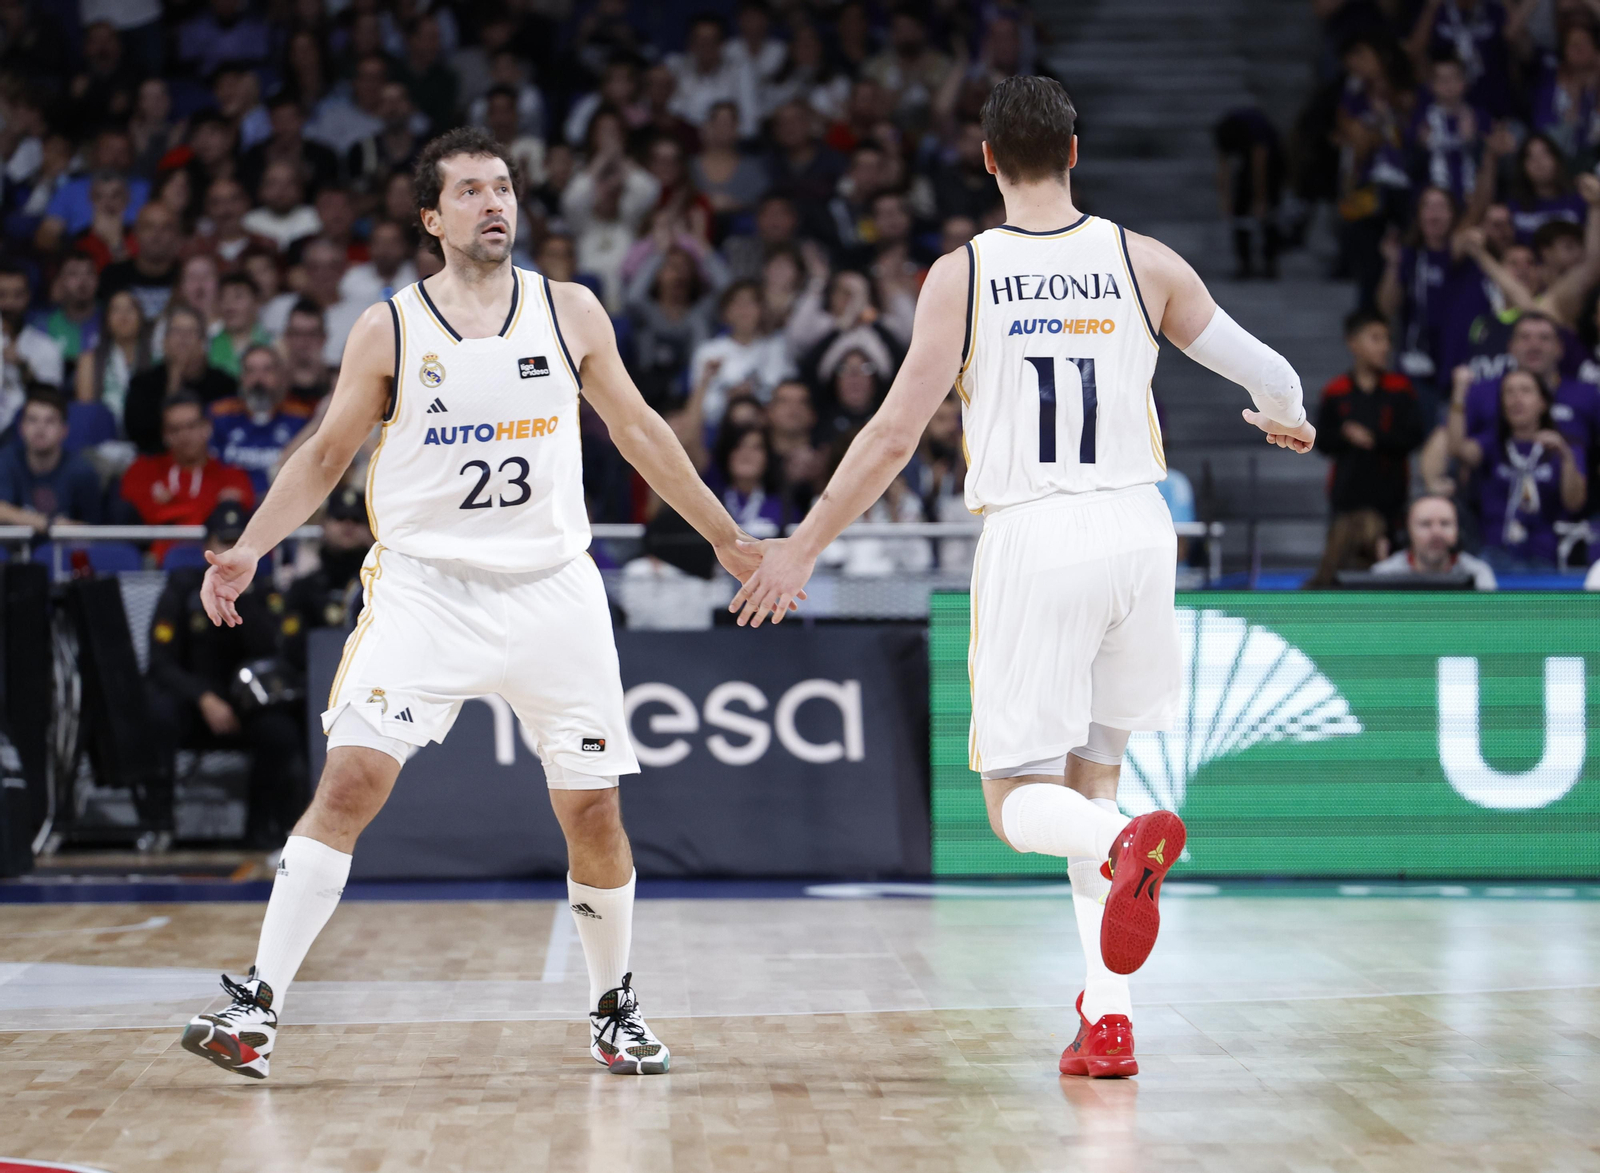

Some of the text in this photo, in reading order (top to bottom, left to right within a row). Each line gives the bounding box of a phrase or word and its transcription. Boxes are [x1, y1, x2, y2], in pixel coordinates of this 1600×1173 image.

[990, 273, 1121, 305] HEZONJA
[1008, 319, 1115, 336] AUTOHERO
[1024, 357, 1098, 464] 11
[424, 416, 559, 445] AUTOHERO
[459, 456, 532, 509] 23
[583, 743, 601, 751] acb
[1437, 656, 1586, 809] U
